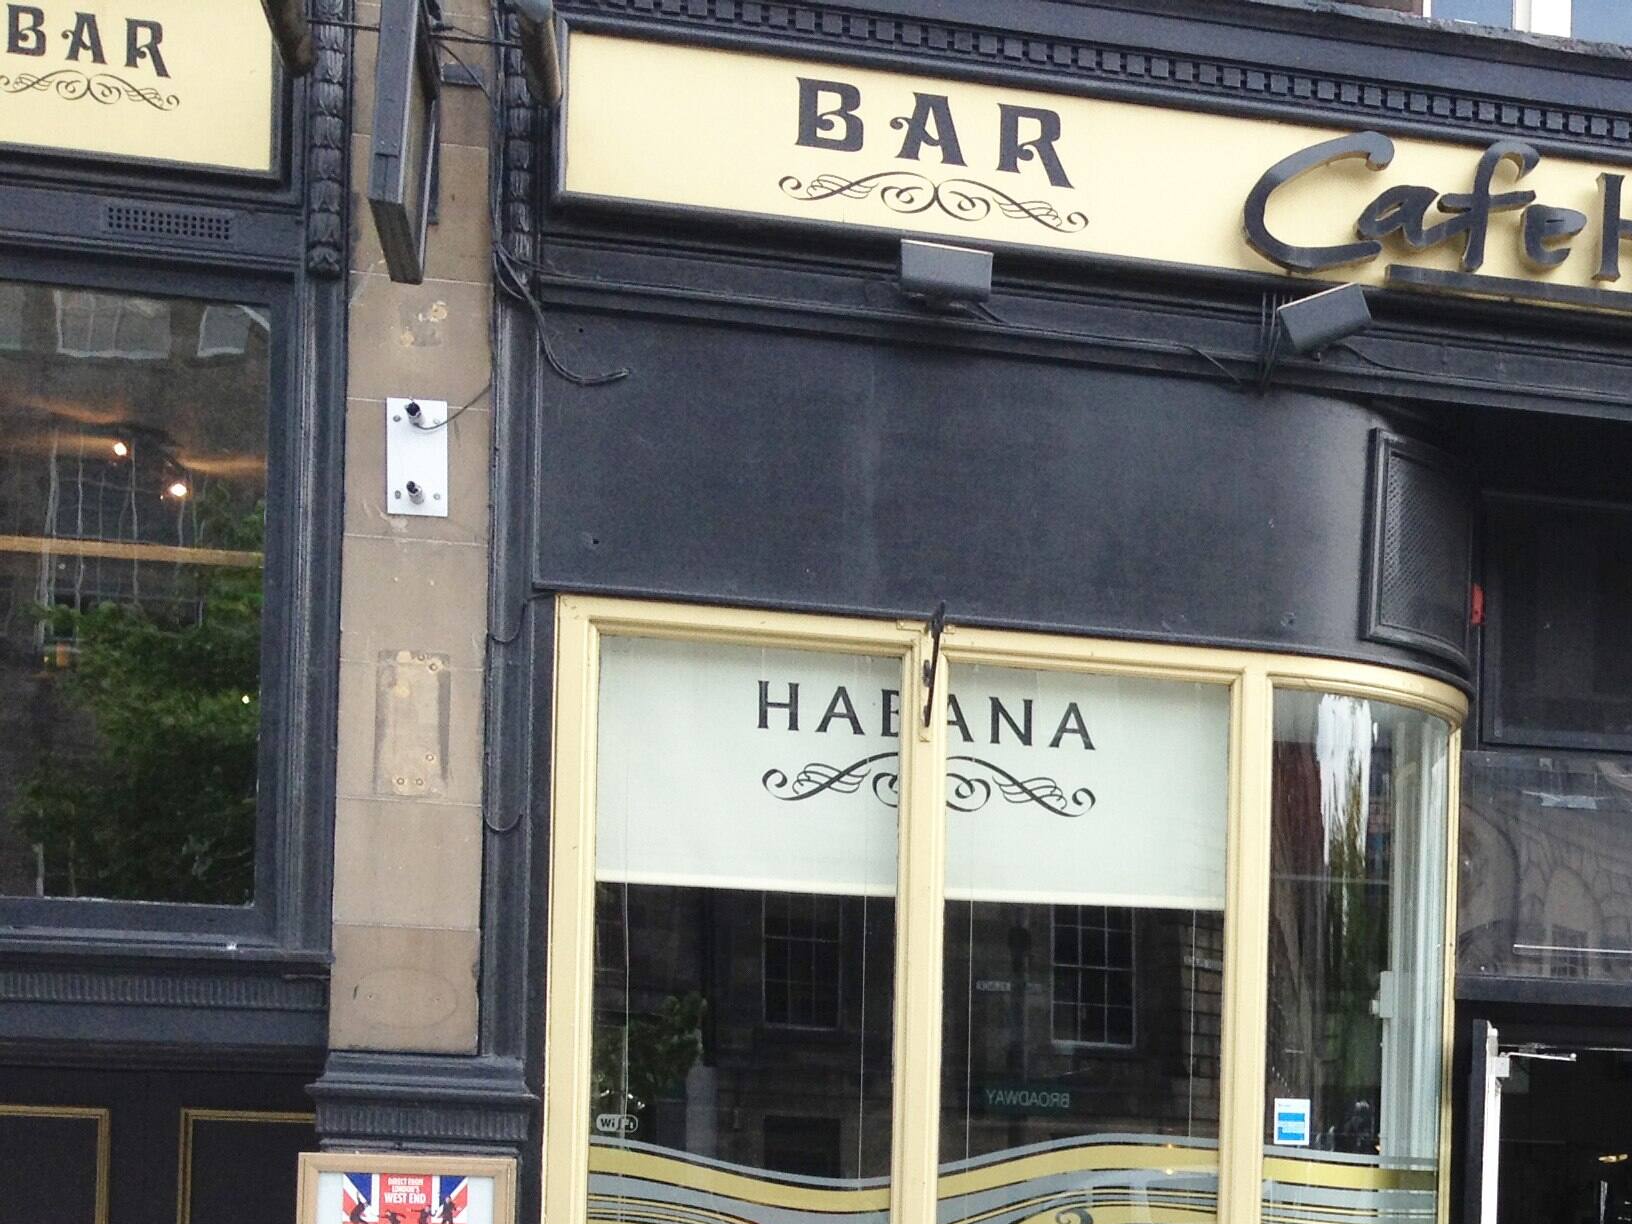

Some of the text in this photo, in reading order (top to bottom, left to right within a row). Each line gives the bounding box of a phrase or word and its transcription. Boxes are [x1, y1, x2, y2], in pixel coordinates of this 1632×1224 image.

[6, 3, 171, 78] BAR
[795, 76, 1075, 189] BAR
[1242, 130, 1587, 274] Cafe
[384, 1192, 427, 1204] WEST END
